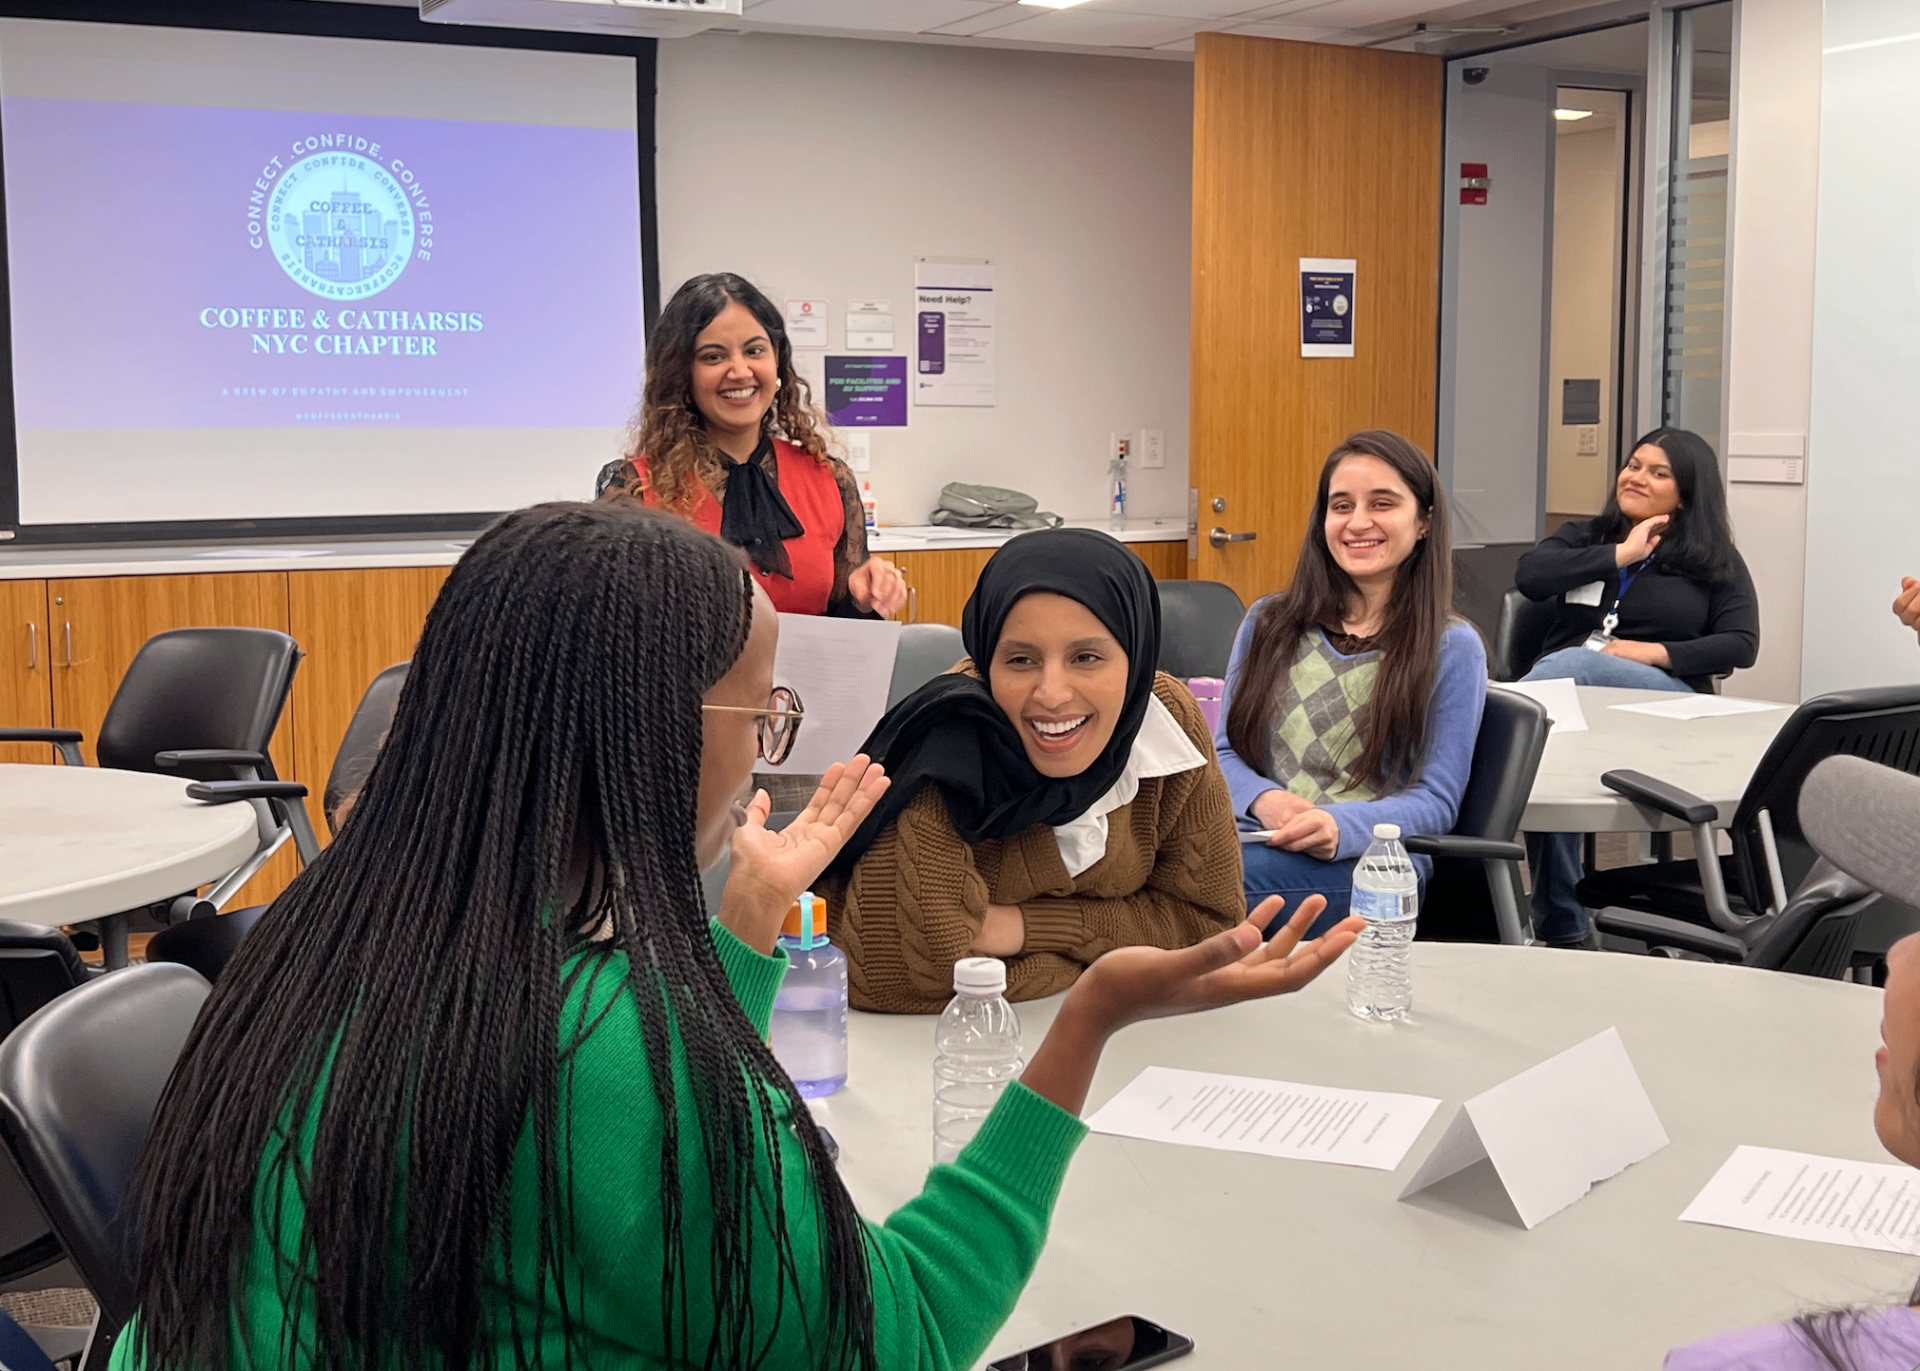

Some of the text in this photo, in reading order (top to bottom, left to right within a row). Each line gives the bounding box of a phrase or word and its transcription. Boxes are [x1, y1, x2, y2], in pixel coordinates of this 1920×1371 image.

[271, 156, 410, 237] CONNECT CONFIDE CONVERSE
[310, 200, 373, 214] COFFEE
[390, 158, 433, 262] CONVERSE
[295, 234, 389, 249] CATHARSIS
[918, 295, 972, 305] Need Help?
[200, 307, 484, 332] COFFEE & CATHARSIS
[251, 333, 438, 356] NYC CHAPTER
[222, 387, 470, 397] A BREW OF EMPATHY AND EMPOWERMENT
